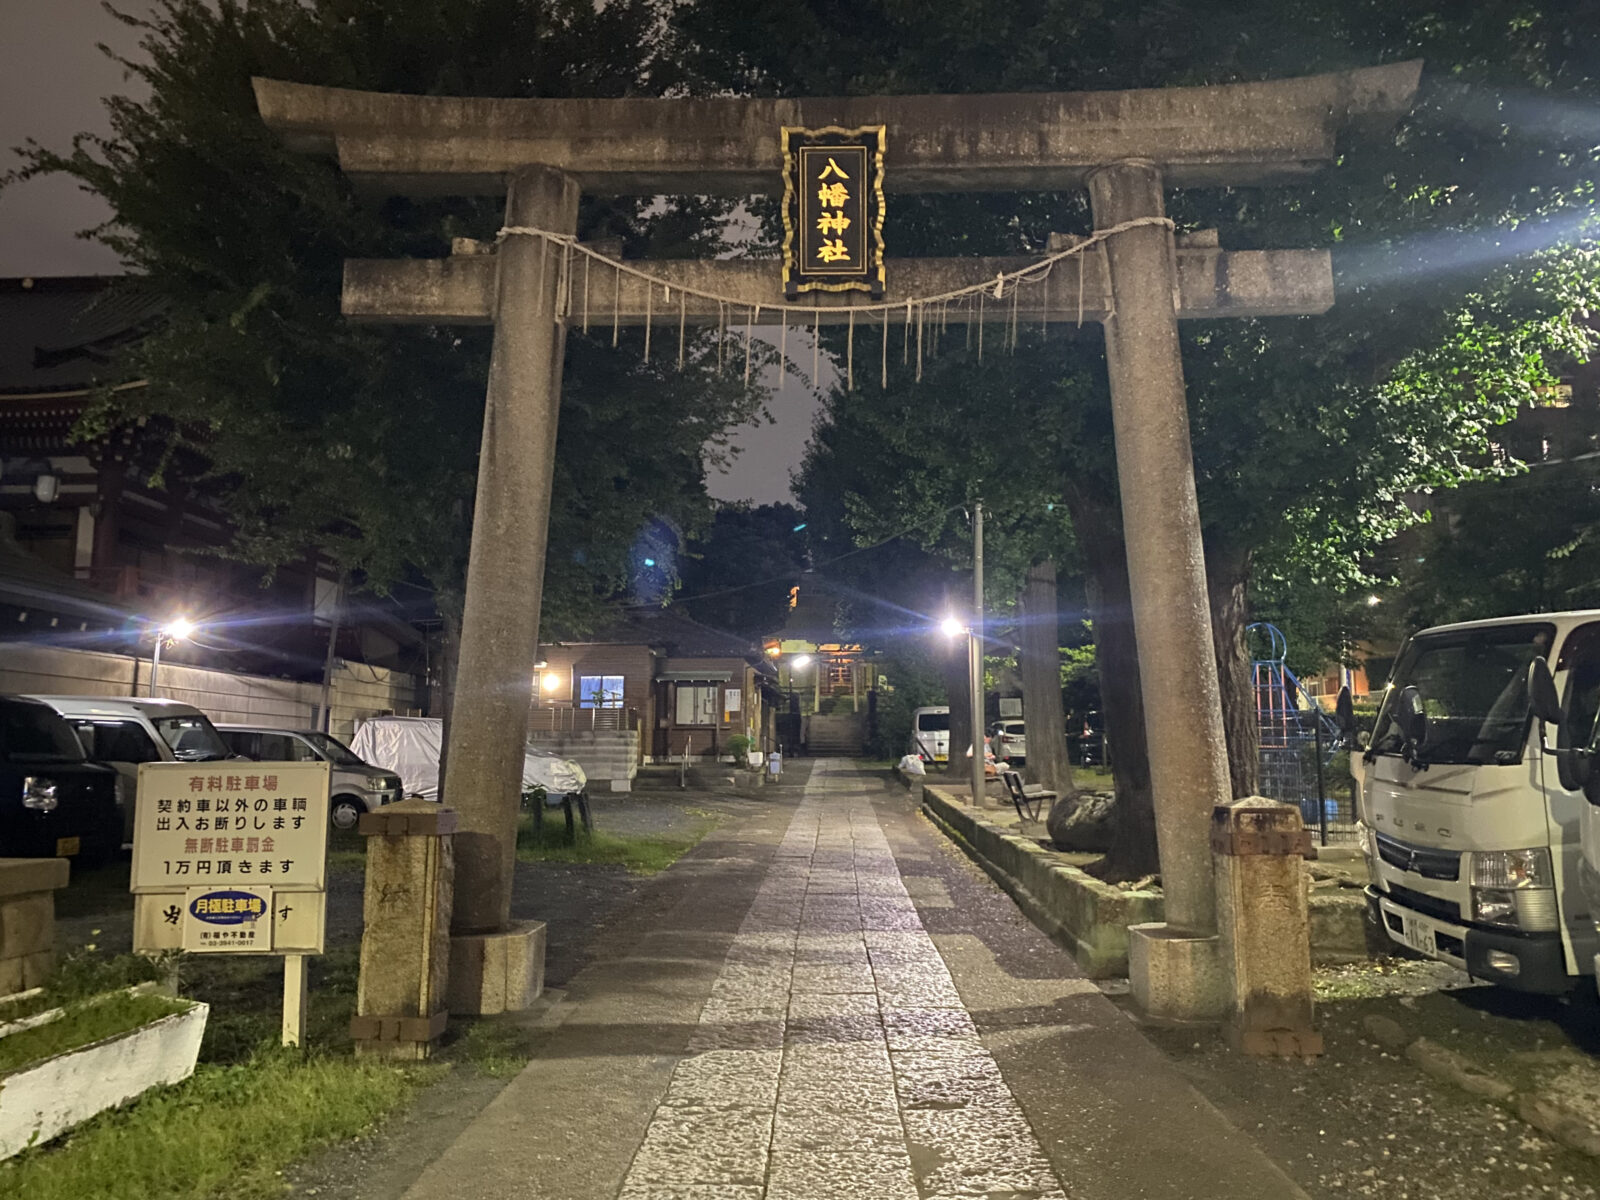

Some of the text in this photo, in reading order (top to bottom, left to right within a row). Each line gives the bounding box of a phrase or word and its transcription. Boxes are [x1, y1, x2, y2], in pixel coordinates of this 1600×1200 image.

[816, 157, 851, 263] 八幡神社
[188, 775, 279, 792] 有料駐車場
[156, 816, 306, 831] 出入お断りします
[184, 836, 276, 854] 無断駐車罰金
[163, 859, 295, 874] 1万円頂きます
[195, 898, 262, 914] 月極駐車場
